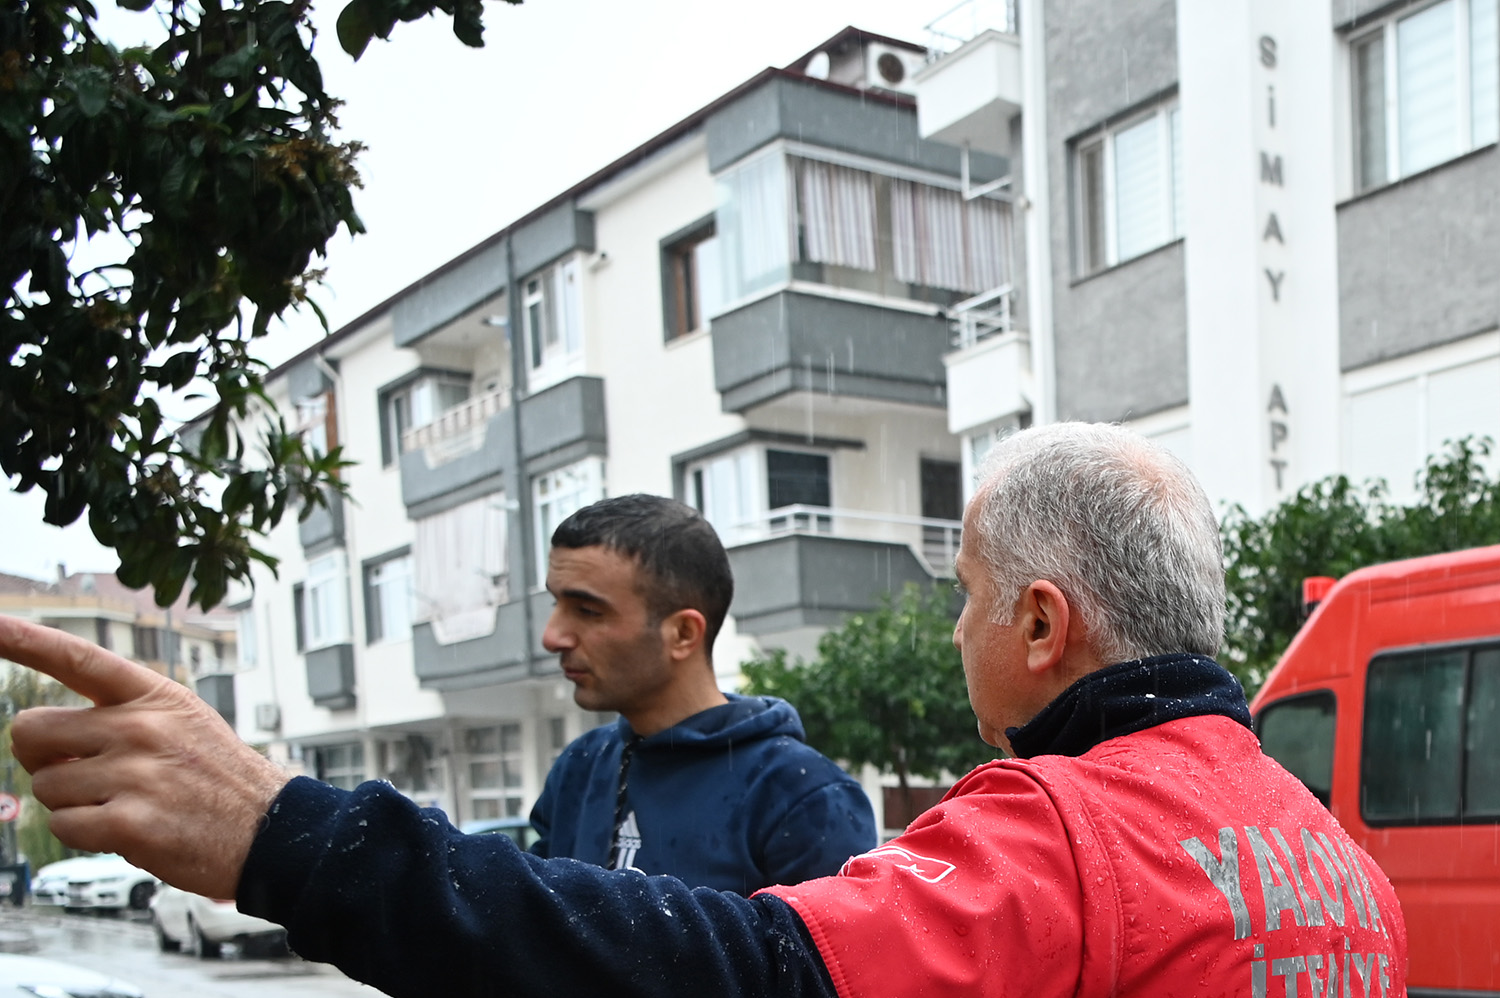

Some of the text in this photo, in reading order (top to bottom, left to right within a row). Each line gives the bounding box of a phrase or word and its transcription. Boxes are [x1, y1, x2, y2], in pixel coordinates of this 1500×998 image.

[1258, 35, 1289, 491] SİMAY APT
[1179, 825, 1390, 941] YALOVA
